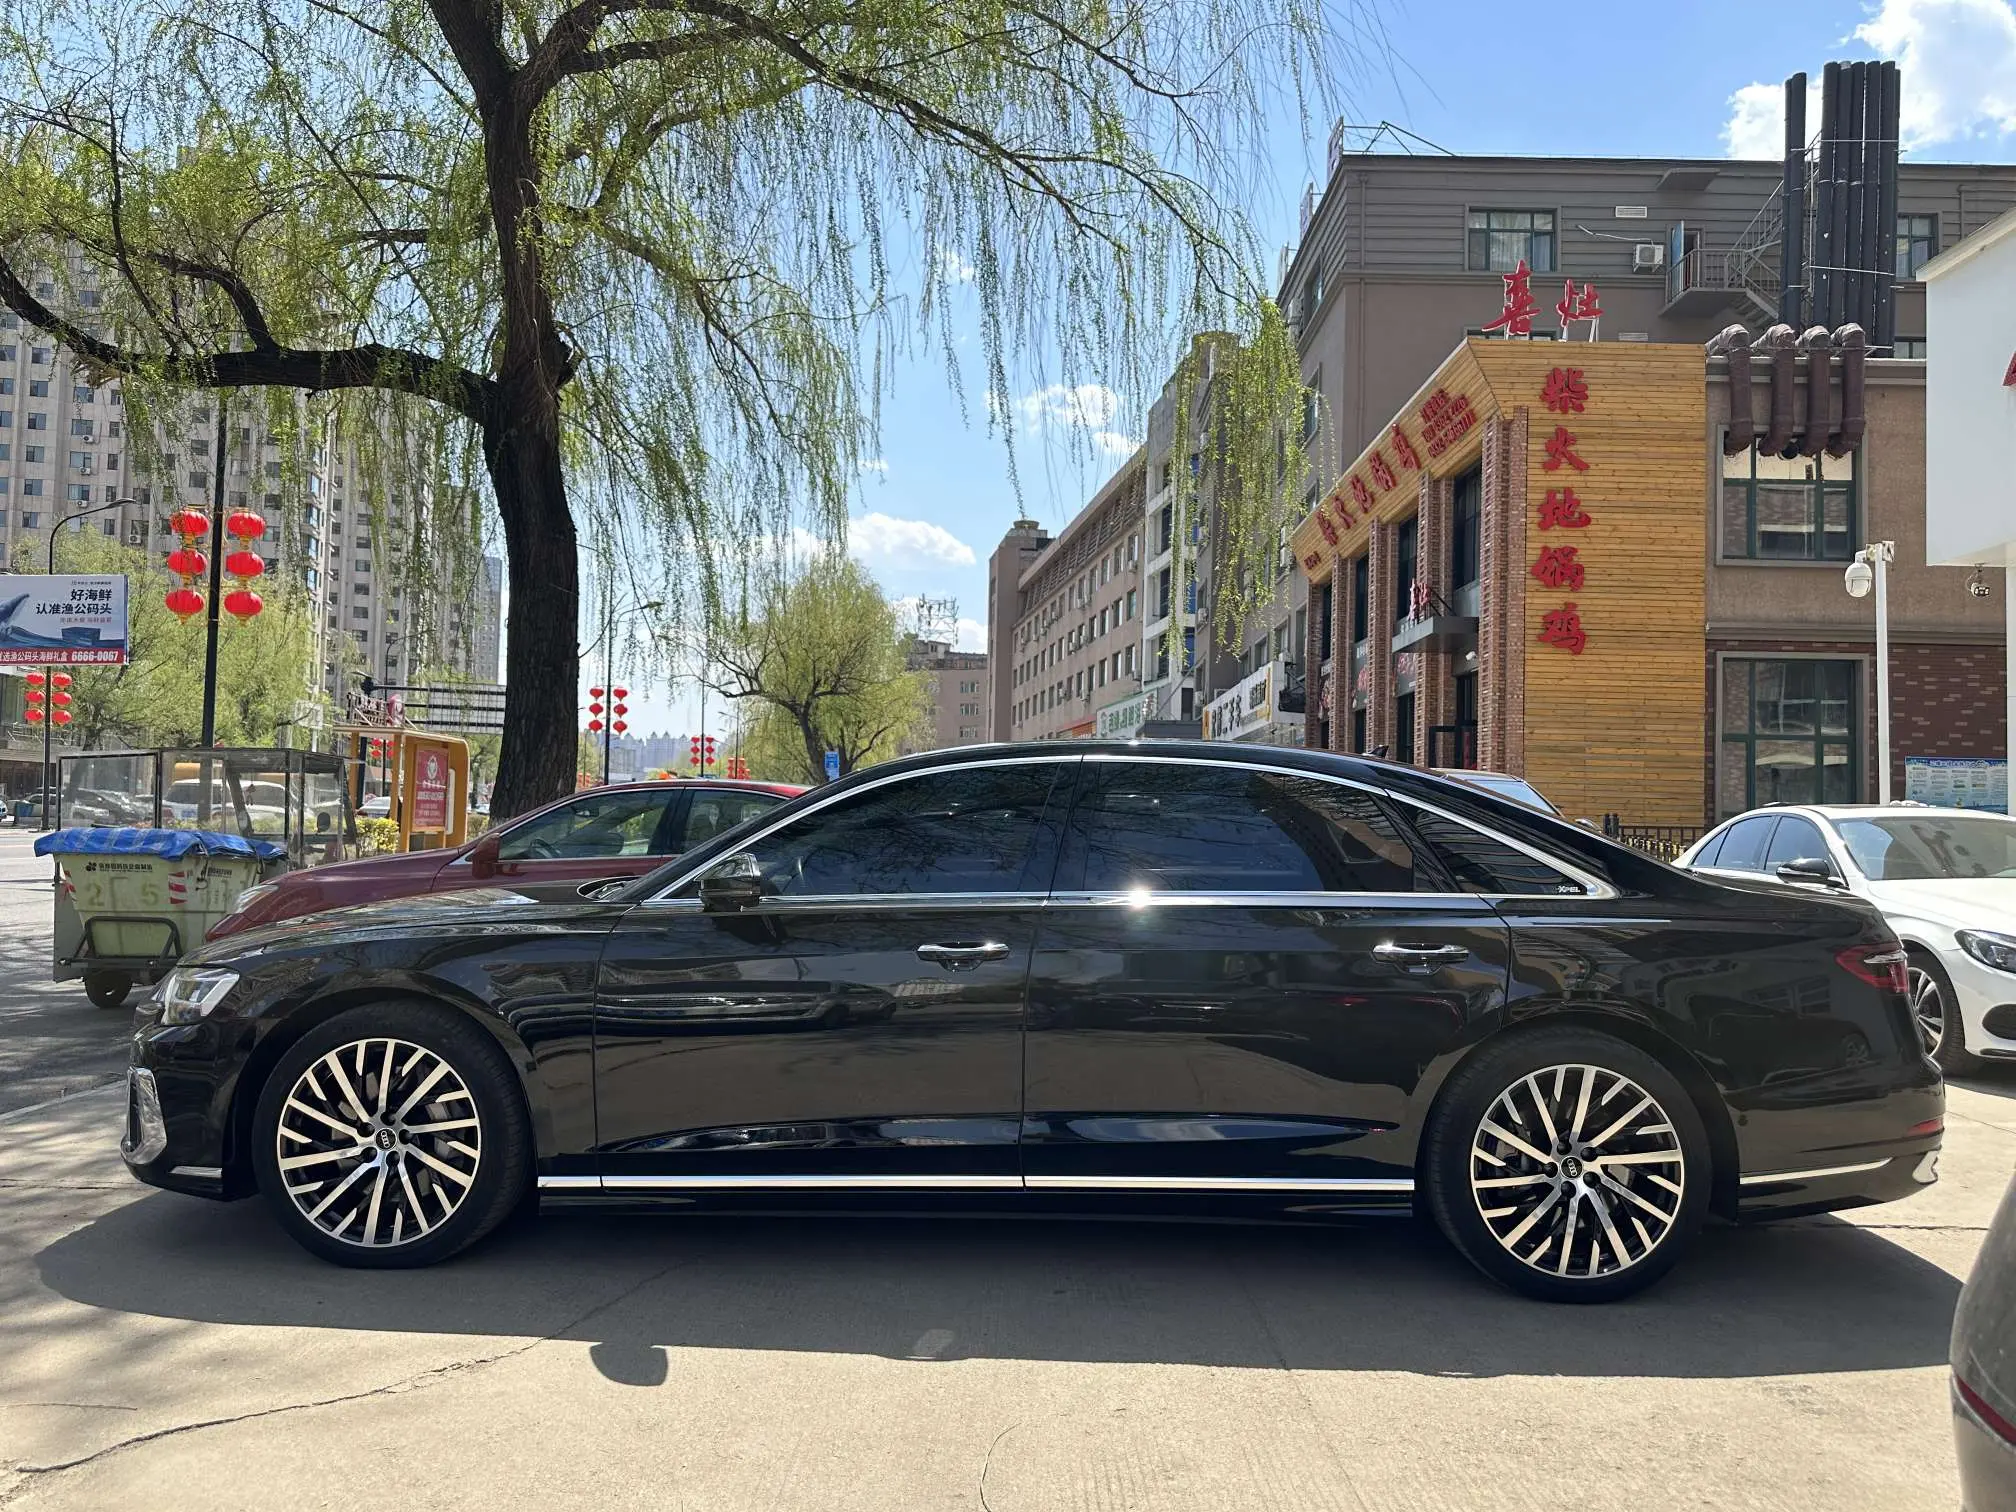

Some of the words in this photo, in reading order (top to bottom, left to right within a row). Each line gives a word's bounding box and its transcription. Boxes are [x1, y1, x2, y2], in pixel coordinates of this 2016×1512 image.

[1530, 367, 1592, 656] 柴火地锅鸡
[70, 589, 112, 601] 好海鲜
[36, 602, 112, 615] 认准渔公码头
[71, 650, 119, 662] 6666-0067
[1558, 885, 1581, 893] XPEL
